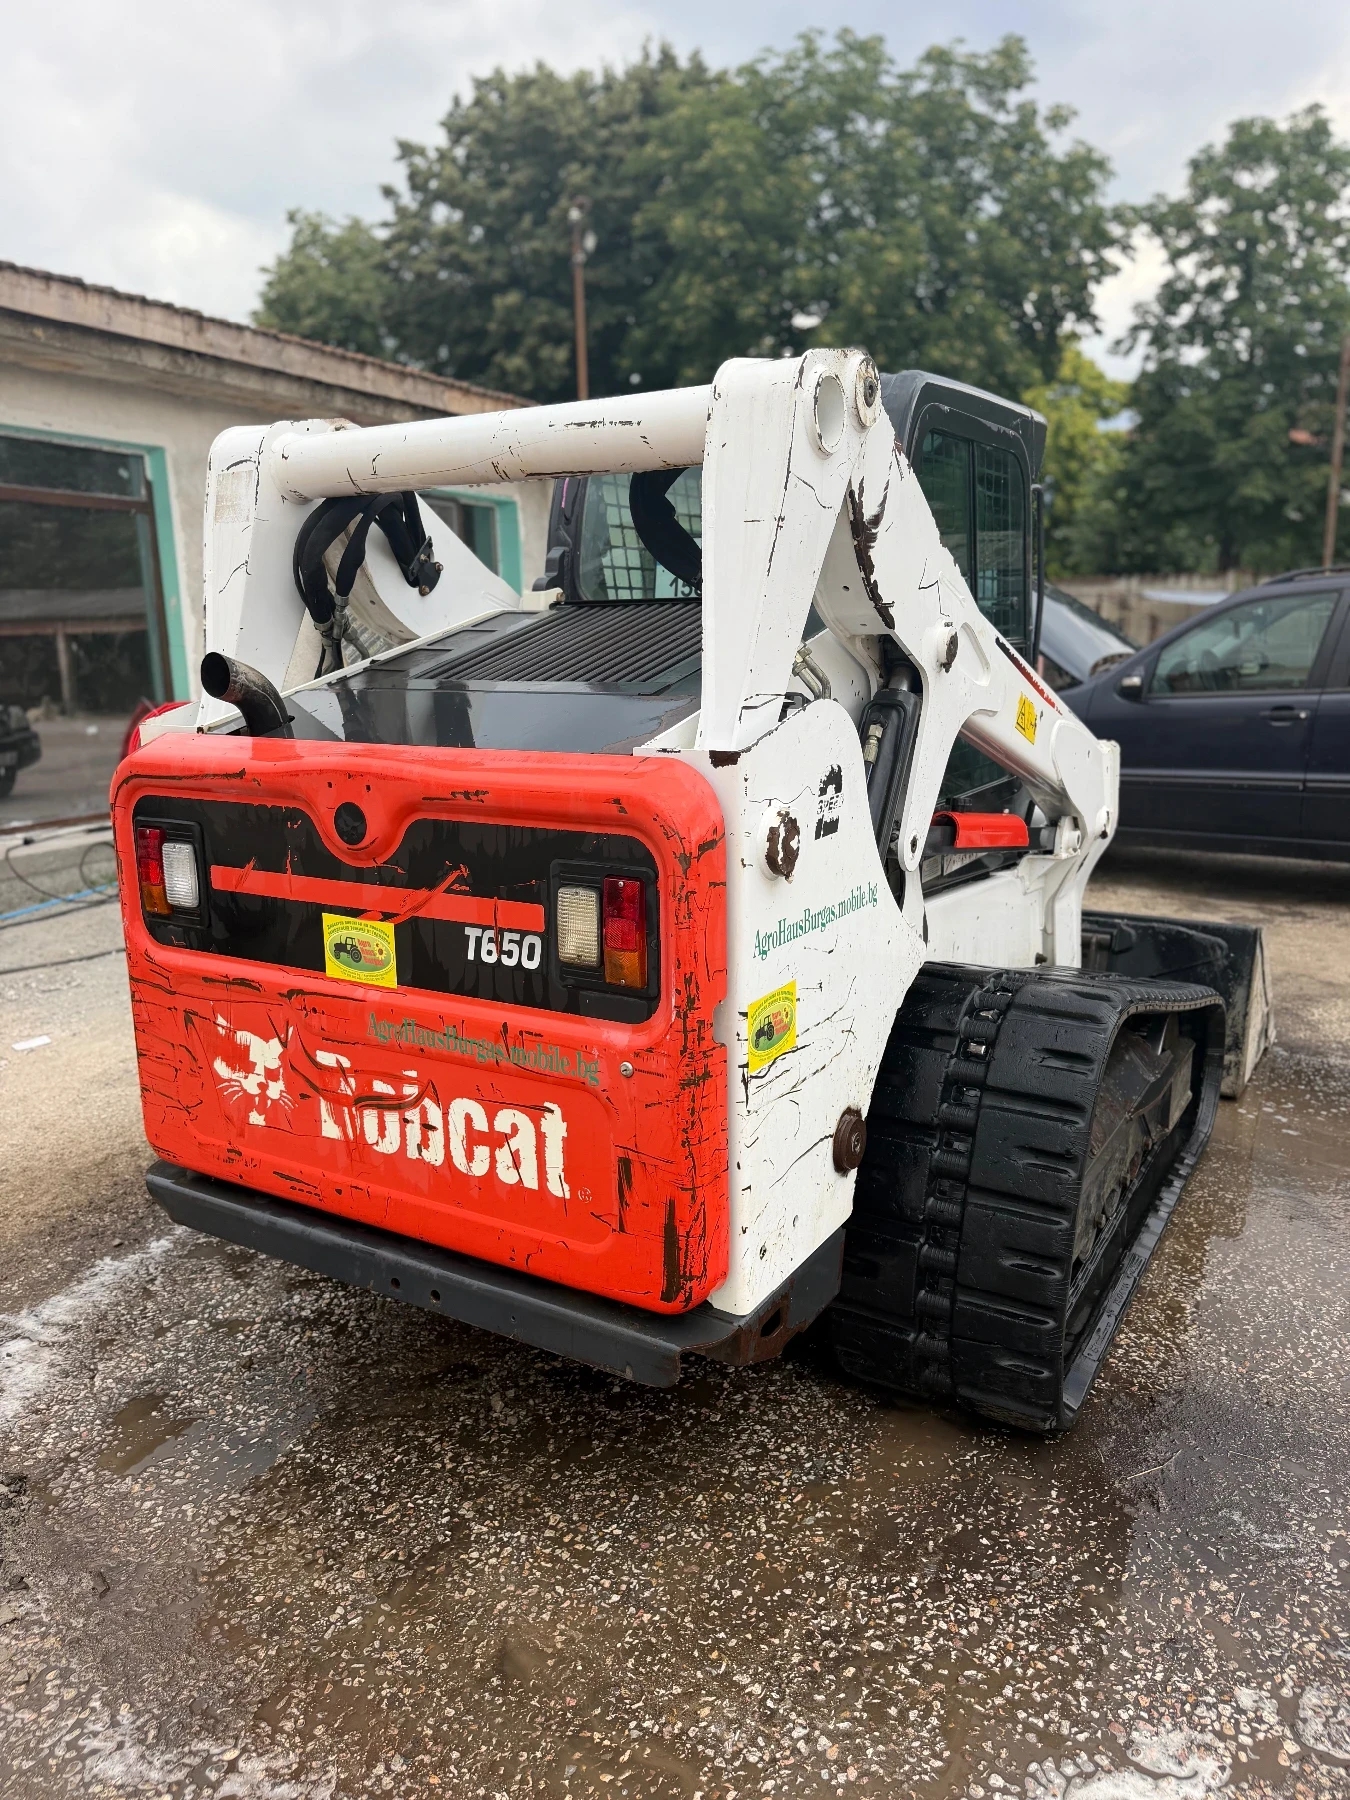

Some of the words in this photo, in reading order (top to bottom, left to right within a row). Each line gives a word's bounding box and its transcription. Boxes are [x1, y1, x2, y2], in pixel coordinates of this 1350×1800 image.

[669, 576, 702, 598] 15
[464, 926, 542, 970] T650
[752, 881, 878, 961] AgroHausBurgas.mobile.bg
[367, 1011, 600, 1087] AgroHausBurgas.mobile.bg
